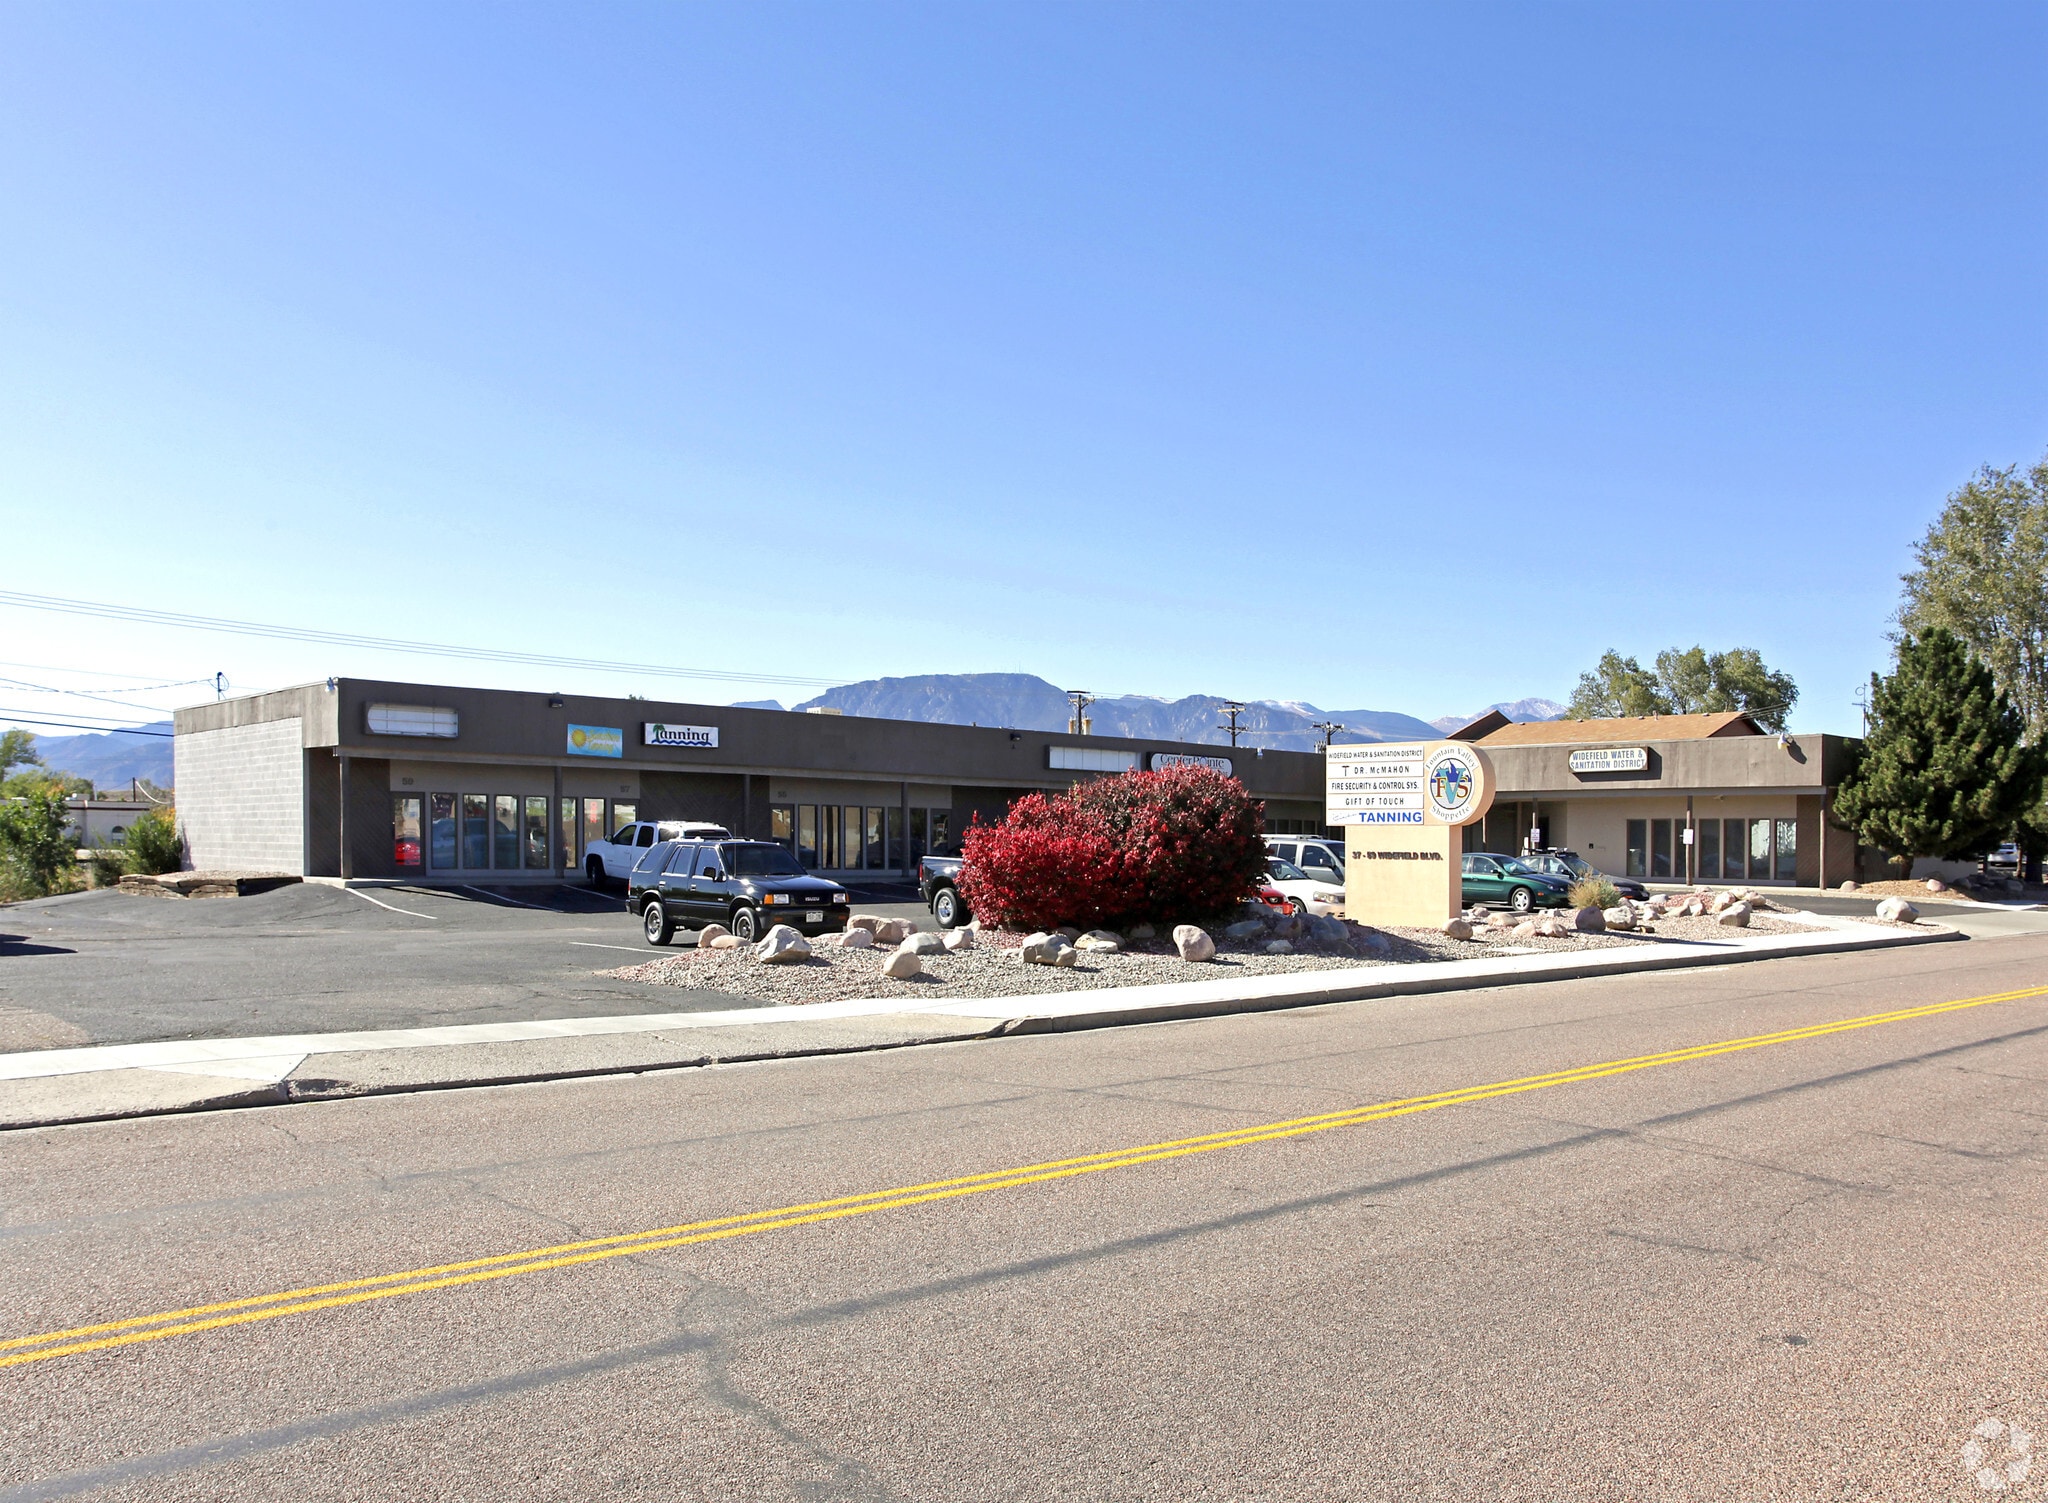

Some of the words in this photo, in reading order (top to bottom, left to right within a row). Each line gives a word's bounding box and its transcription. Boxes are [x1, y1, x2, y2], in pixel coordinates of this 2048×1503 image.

[653, 724, 709, 743] Tanning
[1401, 749, 1422, 757] DISTRICT
[1425, 748, 1455, 769] Fountain
[1457, 747, 1476, 768] Valley
[1572, 751, 1608, 761] WIDEFIELD
[1611, 750, 1635, 759] WATER
[1638, 750, 1643, 758] &
[1570, 760, 1611, 769] SANITATION
[1613, 759, 1645, 768] DISTRICT
[1354, 766, 1368, 774] DR.
[1370, 765, 1410, 774] McMAHON
[1331, 782, 1344, 790] FIRE
[1345, 782, 1371, 790] SECURITY
[1372, 782, 1377, 790] &
[1379, 781, 1404, 789] CONTROL
[1406, 781, 1420, 789] SYS.
[1366, 797, 1375, 805] OF
[1379, 797, 1404, 805] TOUCH
[1359, 812, 1422, 822] TANNING
[1432, 806, 1470, 820] Shoppette
[1352, 851, 1362, 859] 37
[1377, 851, 1419, 860] WIDEFIELD
[1420, 852, 1443, 861] BLVD.
